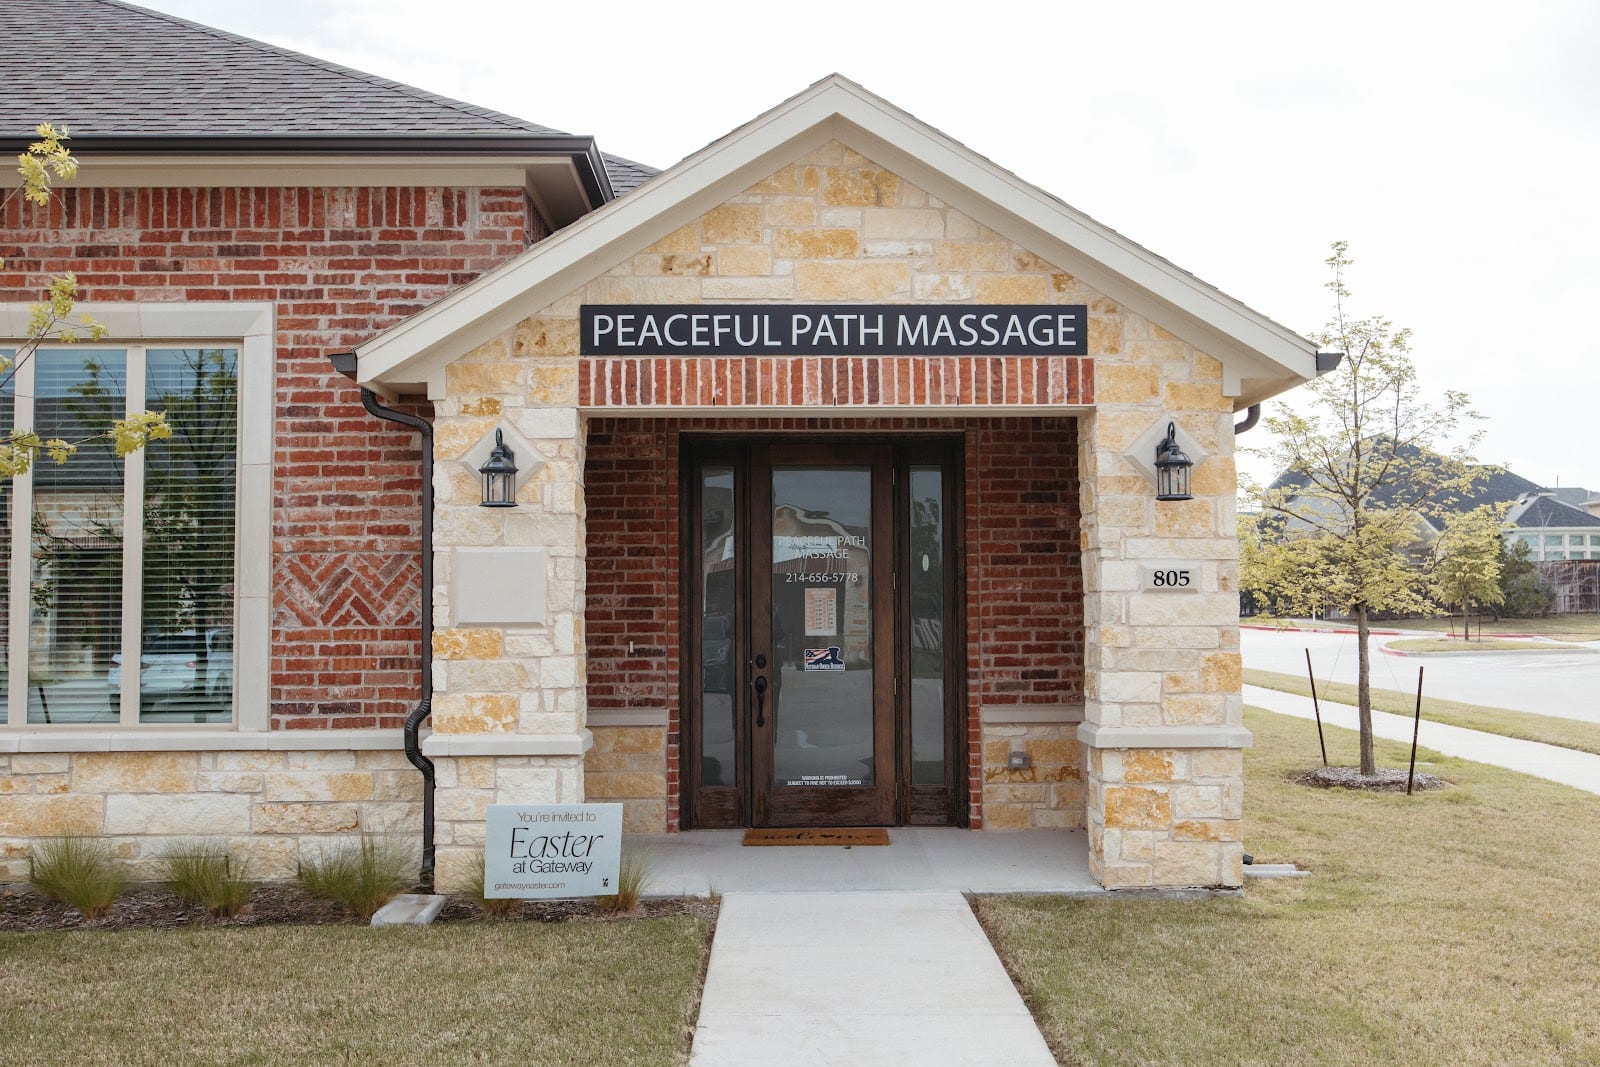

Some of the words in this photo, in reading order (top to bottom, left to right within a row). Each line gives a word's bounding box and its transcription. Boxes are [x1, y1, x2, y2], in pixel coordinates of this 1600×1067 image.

[592, 313, 782, 347] PEACEFUL
[791, 313, 884, 346] PATH
[897, 313, 1077, 346] MASSAGE
[837, 536, 865, 546] PATH
[795, 549, 849, 559] MASSAGE
[785, 573, 858, 583] 214-656-5778
[1153, 570, 1190, 587] 805
[517, 811, 550, 823] You're
[551, 811, 584, 822] invited
[585, 812, 597, 822] to
[510, 827, 604, 859] Easter
[512, 861, 527, 874] at
[529, 859, 593, 875] Gateway
